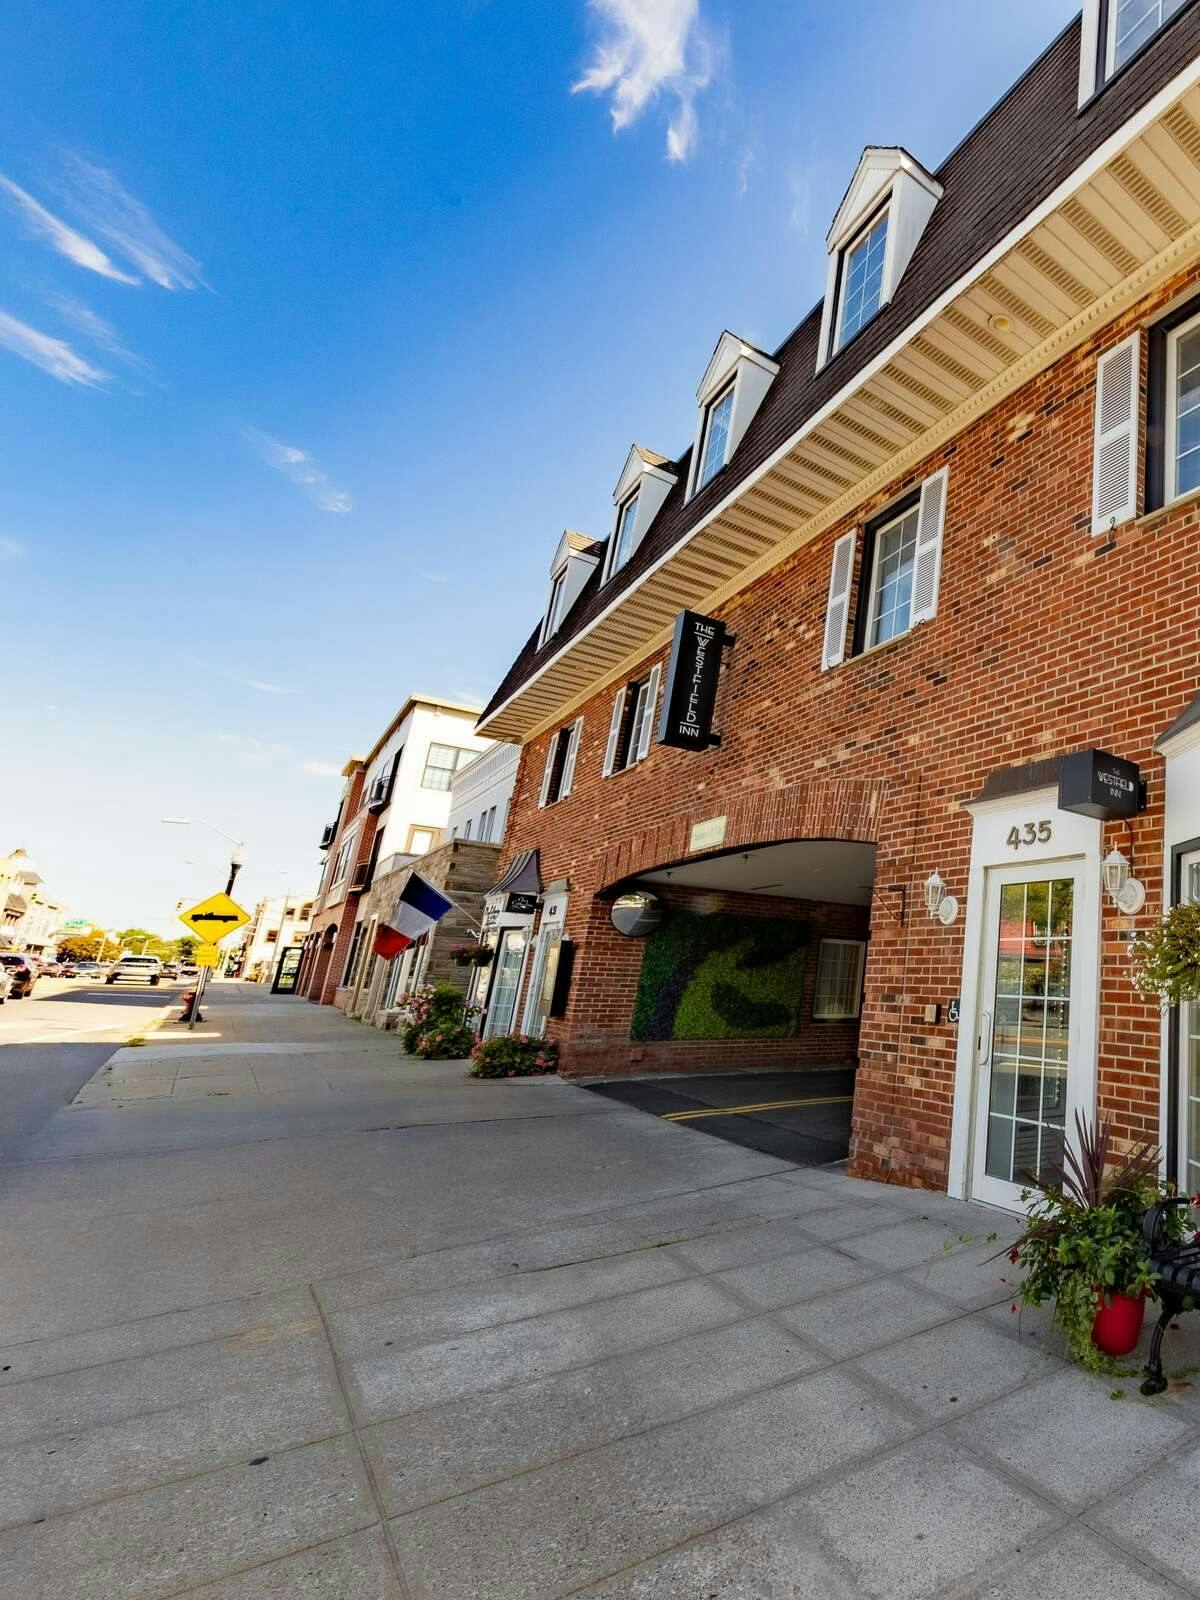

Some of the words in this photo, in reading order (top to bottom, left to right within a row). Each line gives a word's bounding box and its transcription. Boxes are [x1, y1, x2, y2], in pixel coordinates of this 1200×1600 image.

[694, 622, 716, 636] THE
[686, 635, 710, 722] WESTFIELD
[679, 725, 700, 737] INN
[1006, 819, 1052, 850] 435
